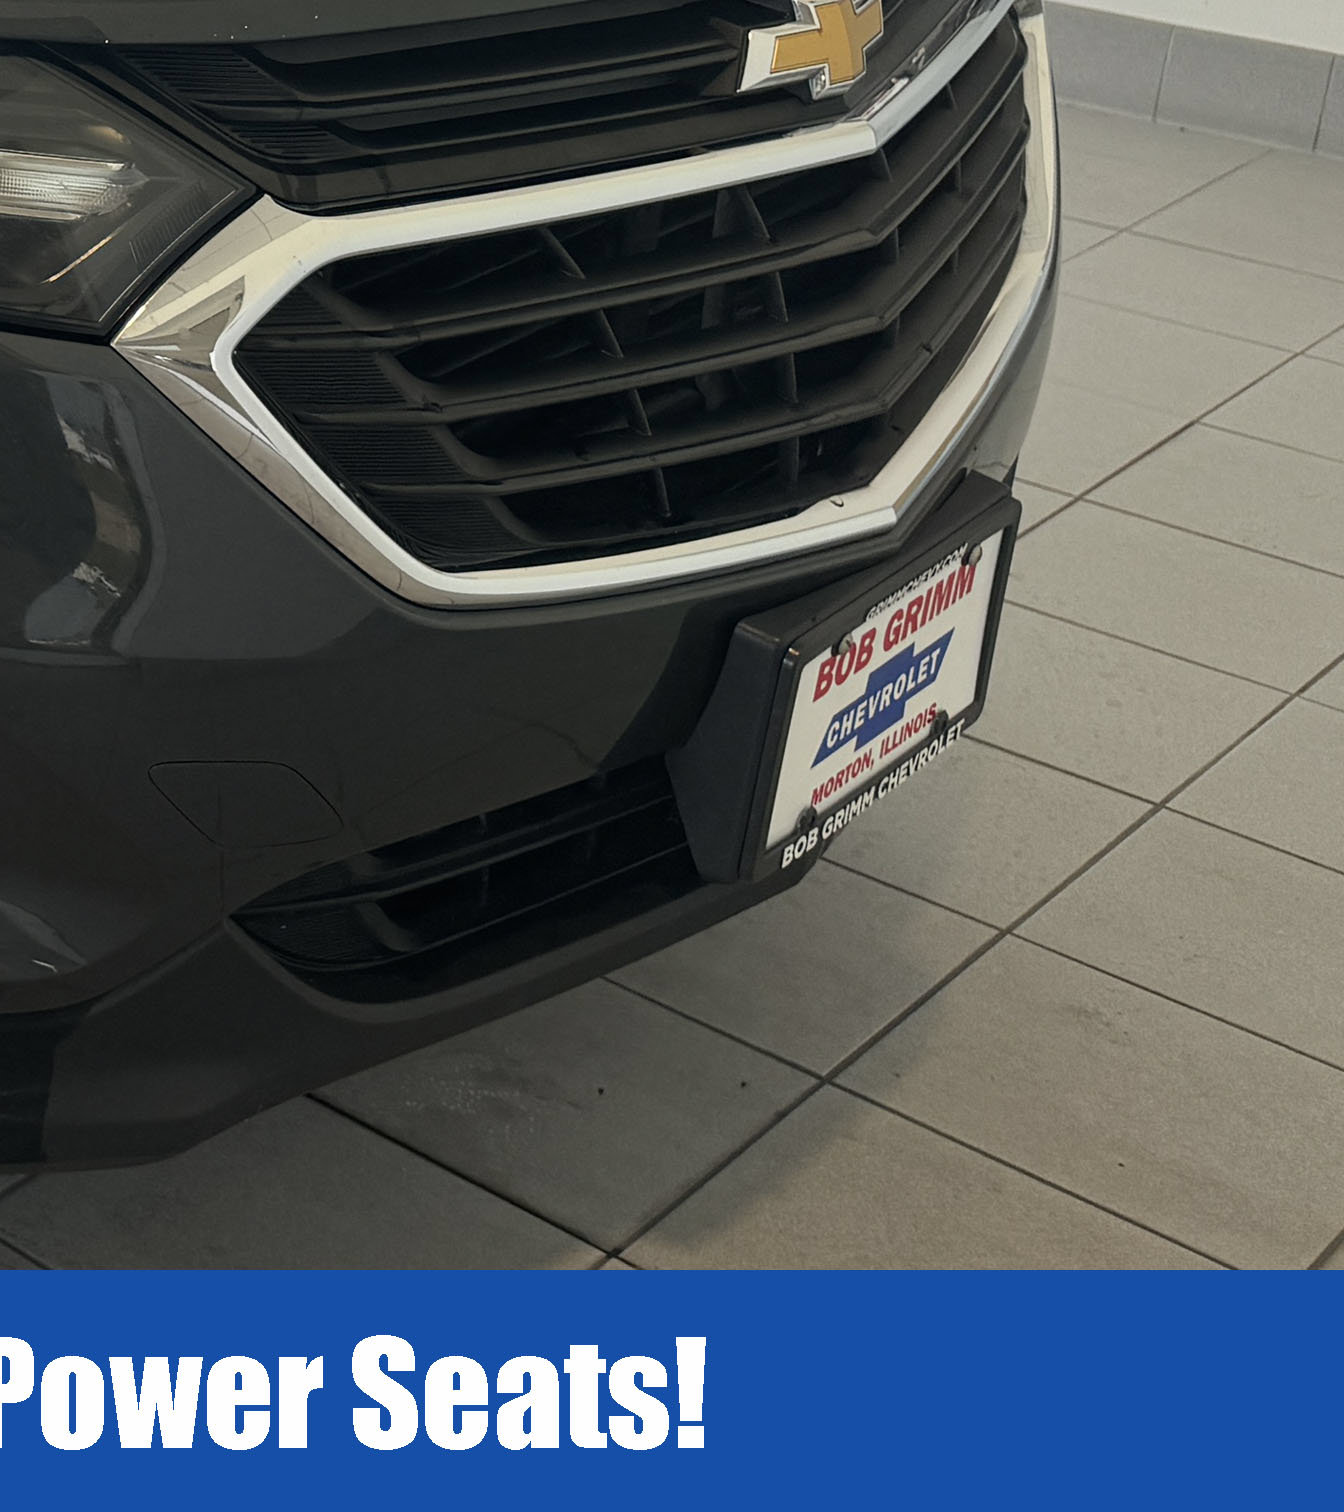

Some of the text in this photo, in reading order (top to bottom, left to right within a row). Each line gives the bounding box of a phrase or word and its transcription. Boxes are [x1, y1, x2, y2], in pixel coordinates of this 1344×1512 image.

[813, 564, 977, 703] BOB GRIMM
[812, 702, 938, 806] MORTON, ILLINOIS
[826, 647, 942, 749] CHEVROLET
[781, 718, 965, 869] BOB GRIMM CHEVROLET
